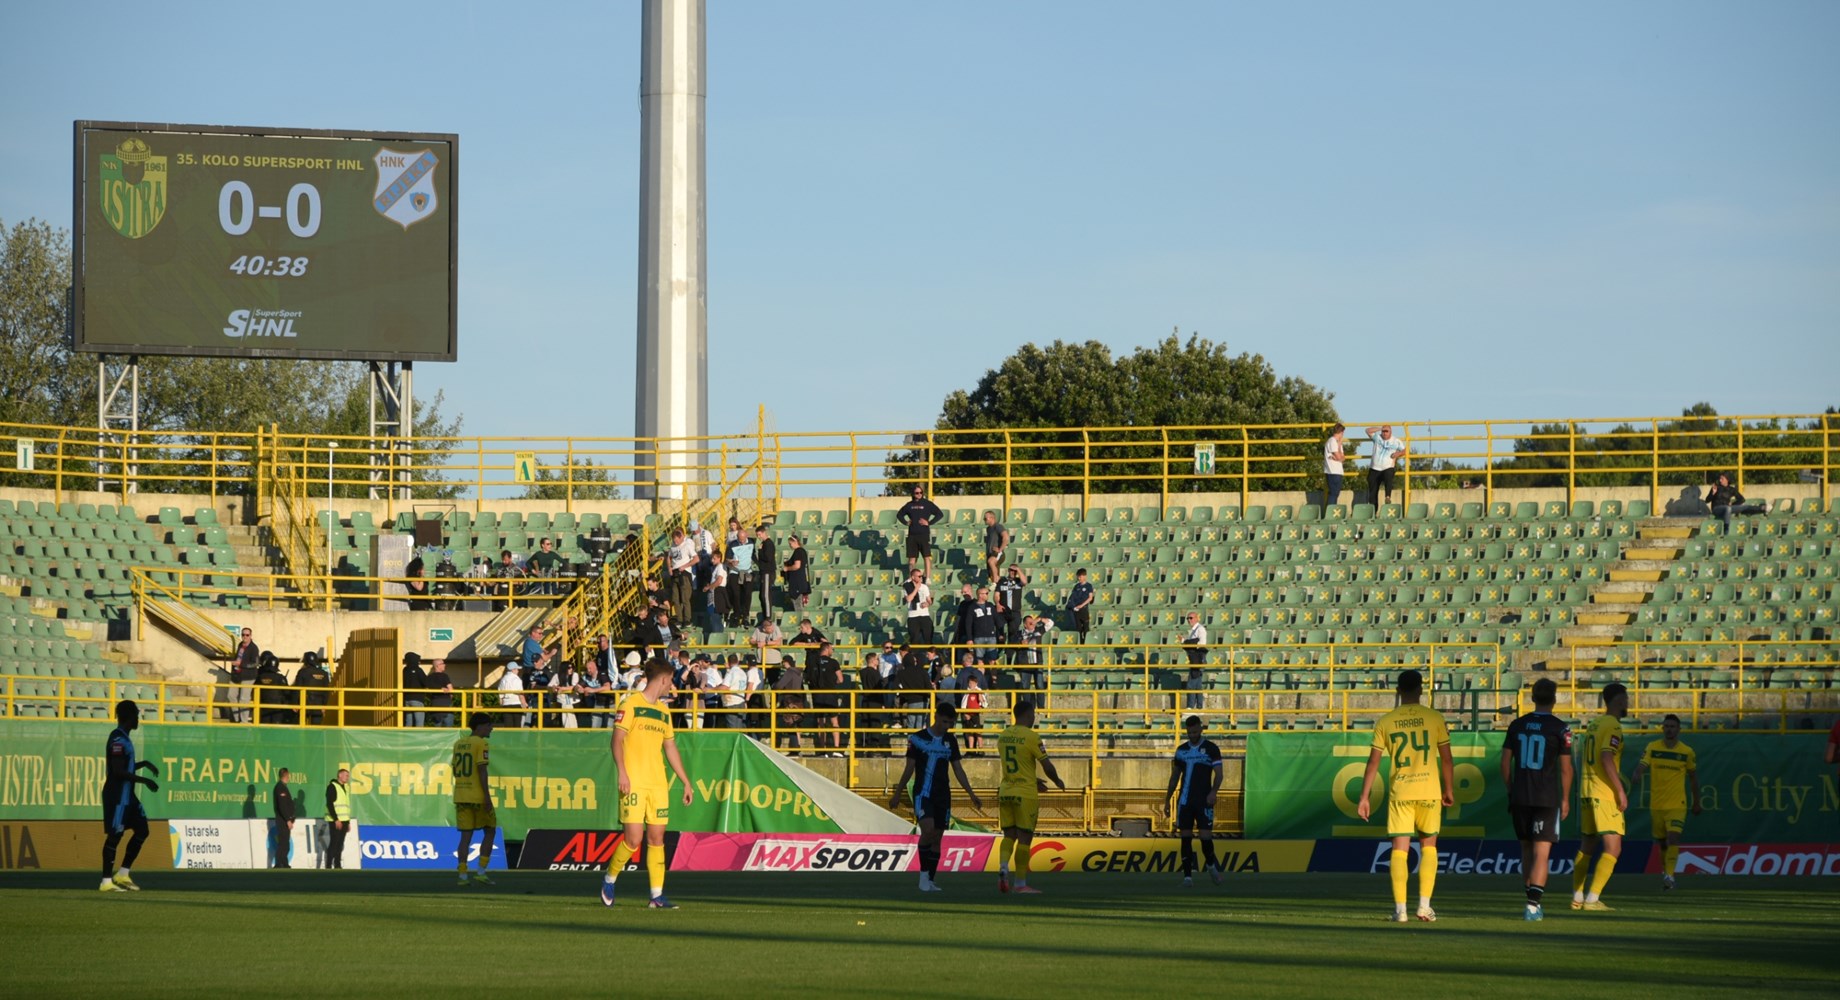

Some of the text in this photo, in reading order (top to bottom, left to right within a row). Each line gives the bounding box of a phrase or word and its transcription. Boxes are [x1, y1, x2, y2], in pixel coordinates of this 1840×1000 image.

[144, 162, 167, 172] 1961
[176, 153, 365, 171] 35. KOLO SUPERSPORT HNL
[380, 155, 405, 168] HNK
[104, 179, 165, 236] ISTRA
[218, 180, 322, 238] 0-0
[229, 255, 309, 277] 40:38
[255, 308, 303, 318] SuperSport
[1393, 718, 1424, 729] TARABA
[1389, 730, 1430, 769] 24
[1518, 733, 1546, 770] 10
[453, 752, 473, 778] 20
[1005, 745, 1019, 774] 5
[162, 756, 308, 785] TRAPAN VARIJA
[173, 790, 211, 803] HRVATSKA
[1731, 772, 1814, 825] City
[184, 824, 220, 838] Istarska
[1532, 820, 1545, 835] A1
[186, 841, 222, 855] Kreditna
[360, 841, 439, 860] oma
[187, 859, 214, 869] Banka
[1081, 849, 1260, 873] GERMANIA
[1436, 854, 1574, 873] Electrux
